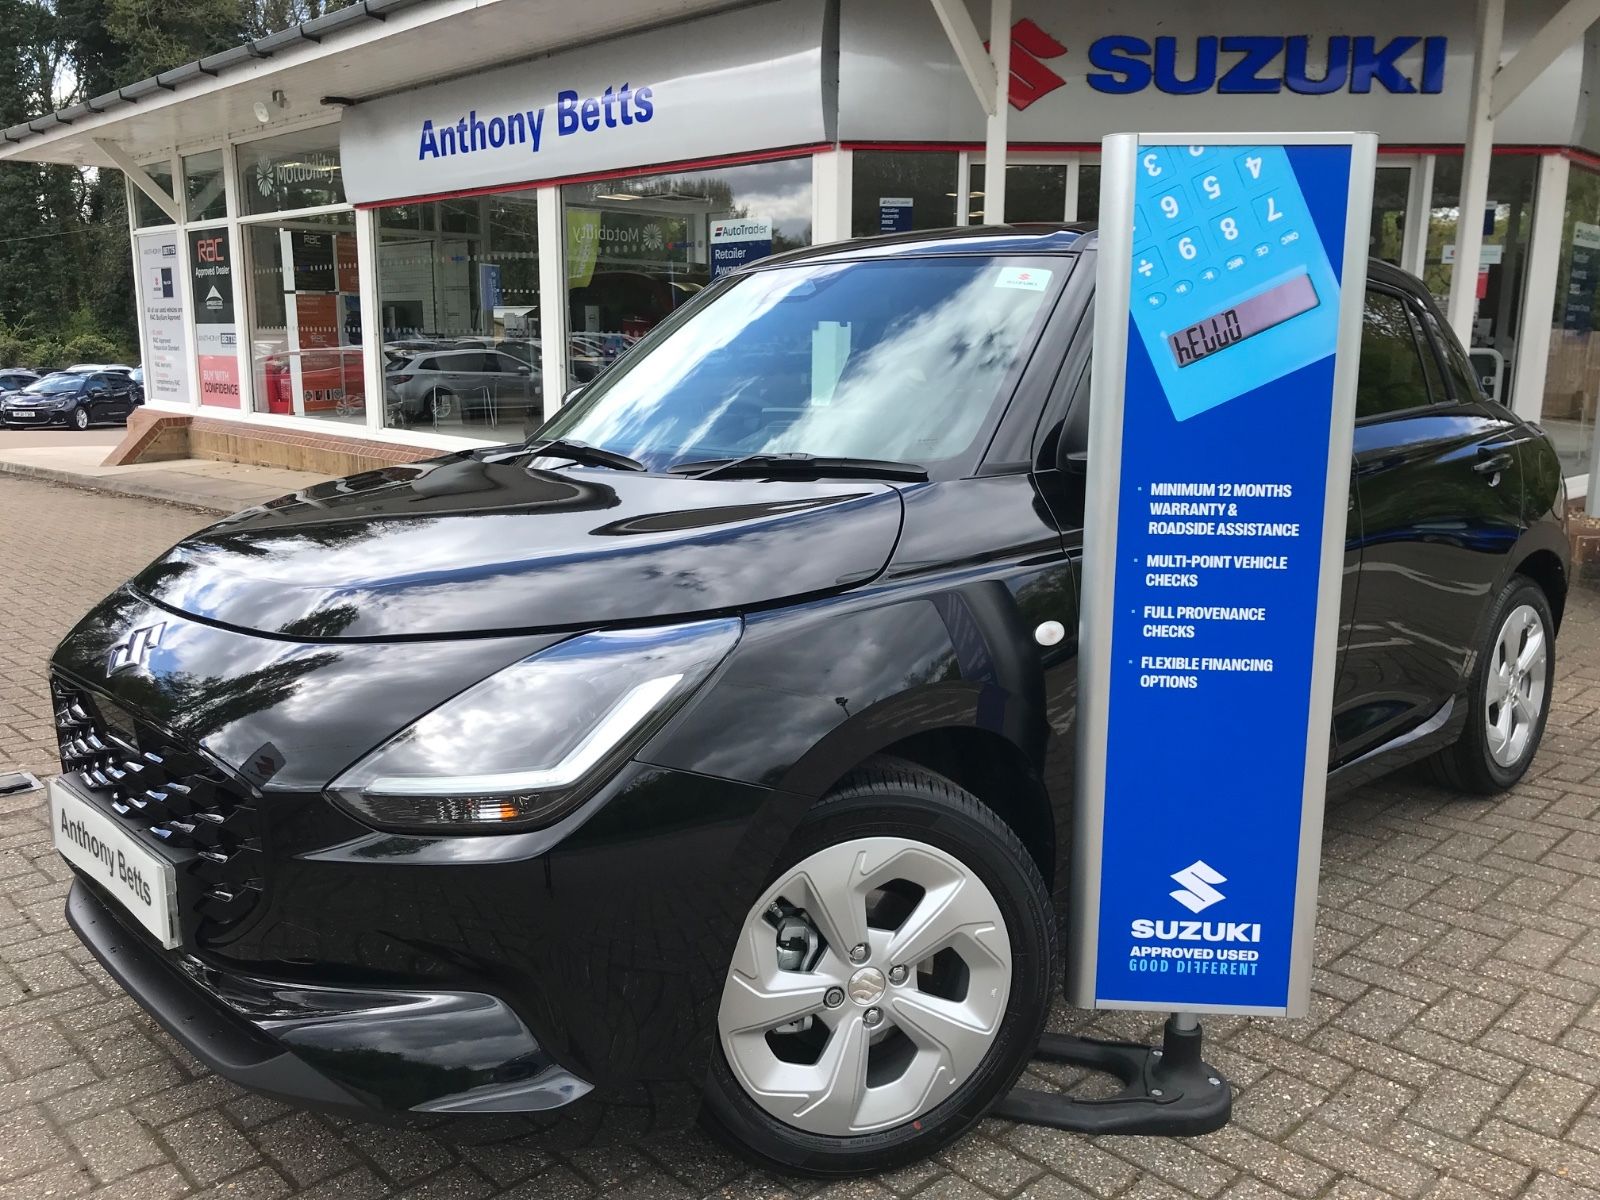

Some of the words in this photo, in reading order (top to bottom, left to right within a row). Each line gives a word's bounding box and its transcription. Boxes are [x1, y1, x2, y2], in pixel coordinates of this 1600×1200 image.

[1086, 34, 1448, 96] SUZUKI
[418, 107, 545, 161] Anthony
[557, 82, 654, 137] Betts
[276, 153, 335, 186] Motability
[722, 224, 768, 237] AutoTrader
[1219, 217, 1239, 241] 8
[714, 247, 747, 260] Retailer
[195, 266, 216, 278] Approved
[216, 265, 230, 275] Dealer
[204, 382, 239, 395] CONFIDENCE
[1150, 483, 1216, 497] MINIMUM
[1217, 483, 1232, 497] 12
[1233, 483, 1292, 498] MONTHS
[1149, 502, 1227, 516] WARRANTY
[1227, 503, 1238, 517] &
[1148, 522, 1215, 536] ROADSIDE
[1216, 522, 1300, 537] ASSISTANCE
[1146, 554, 1232, 569] MULTI-POINT
[1233, 555, 1288, 570] VEHICLE
[1145, 573, 1199, 587] CHECKS
[1143, 605, 1175, 619] FULL
[1176, 606, 1266, 621] PROVENANCE
[1142, 624, 1195, 638] CHECKS
[1140, 656, 1199, 670] FLEXIBLE
[1201, 657, 1273, 672] FINANCING
[1140, 674, 1198, 689] OPTIONS
[61, 807, 115, 878] Anthony
[117, 848, 152, 907] Betts
[1130, 918, 1262, 943] SUZUKI
[1129, 945, 1214, 960] APPROVED
[1216, 948, 1259, 961] USED
[1128, 958, 1169, 973] GOOD
